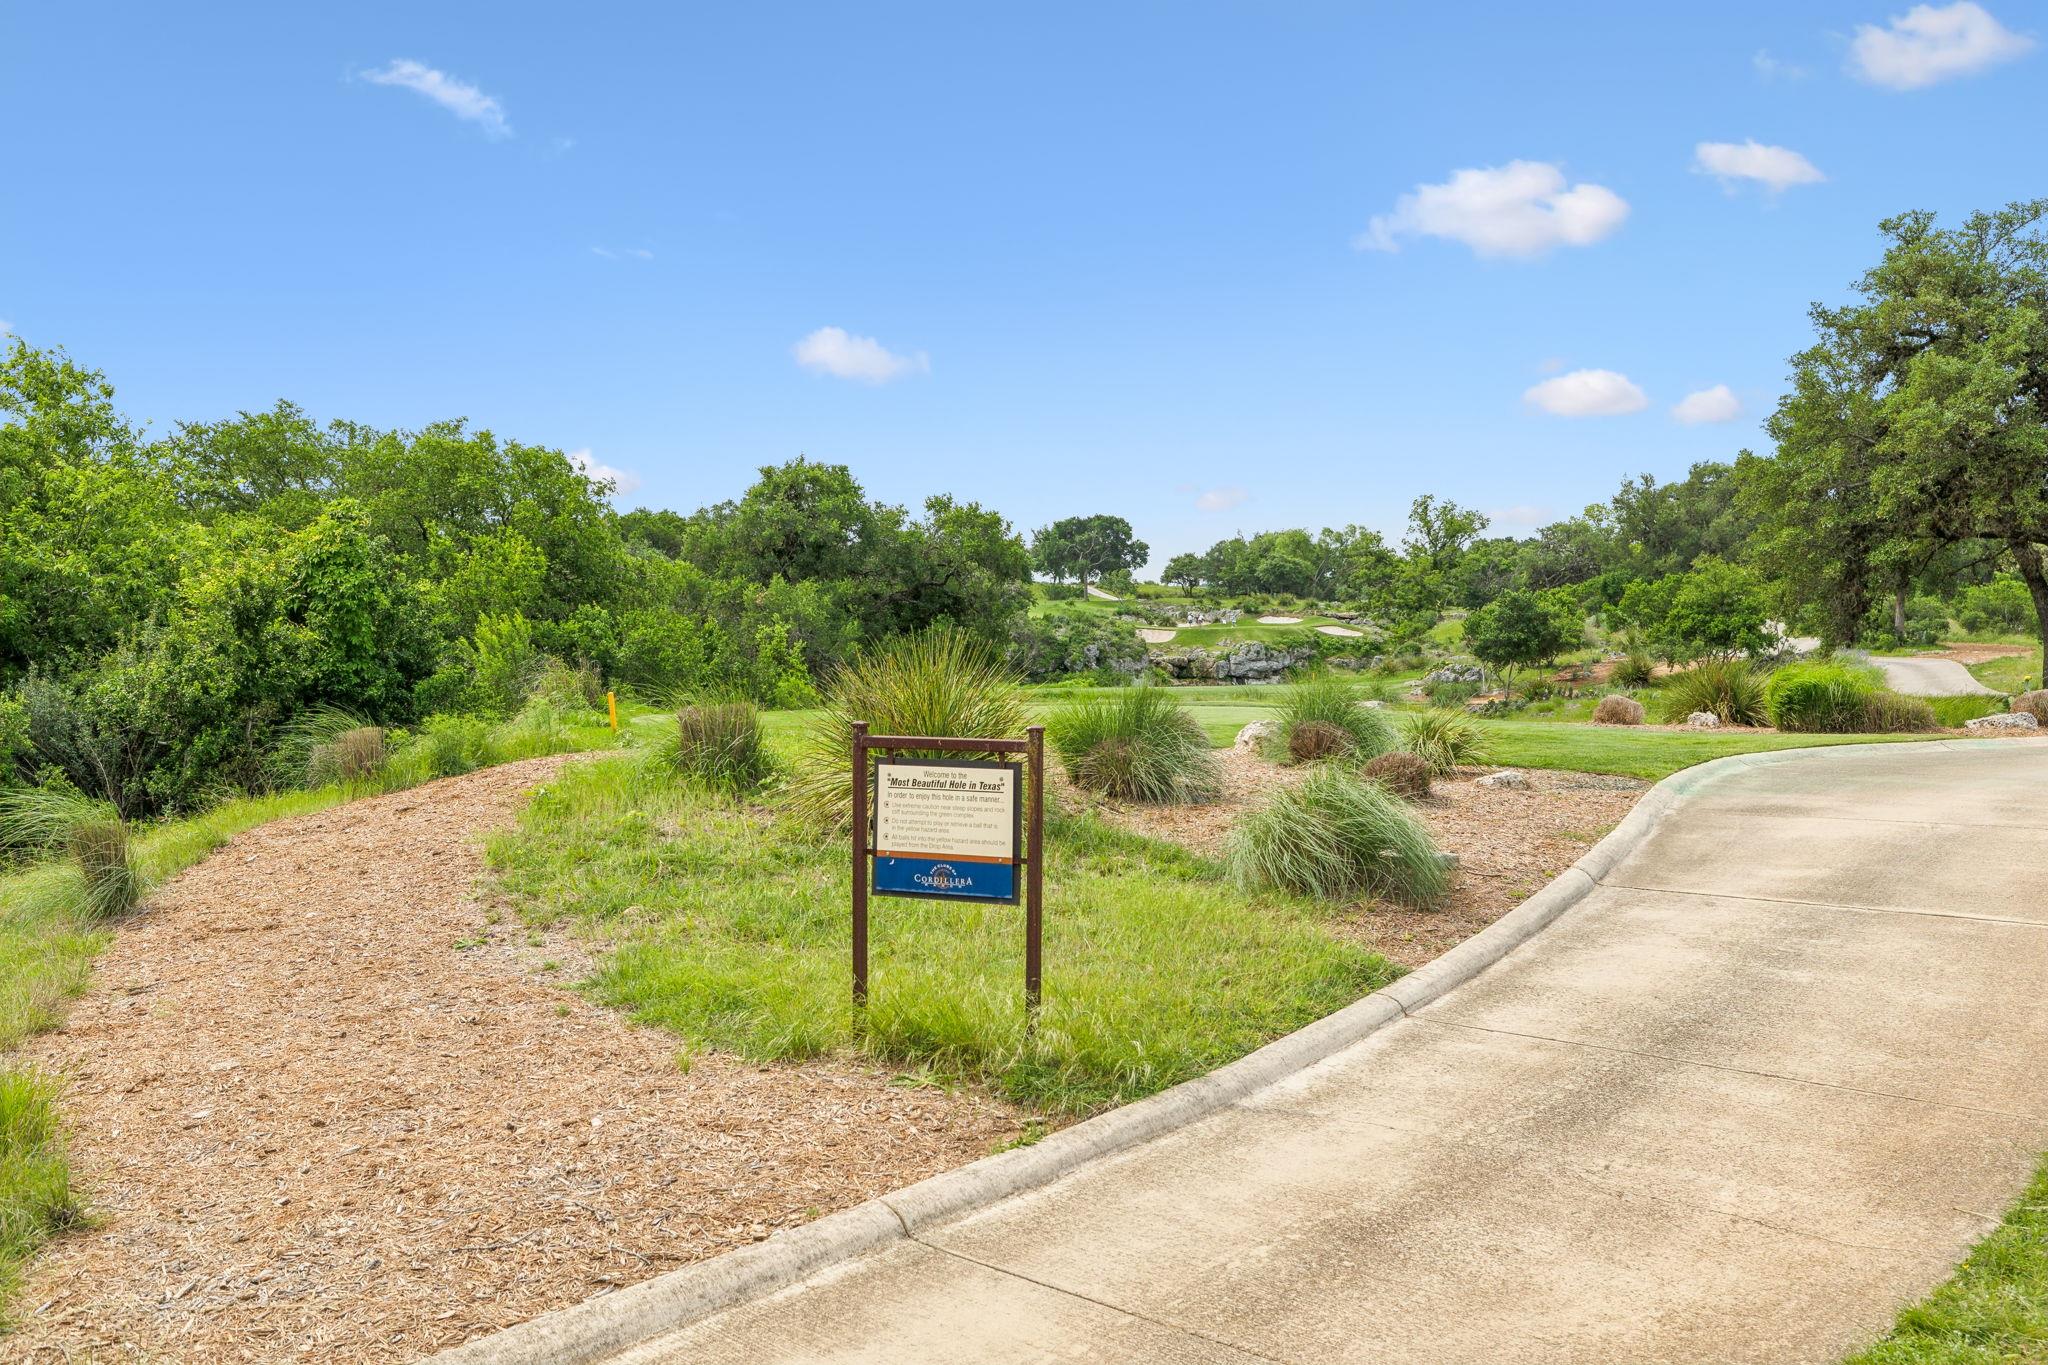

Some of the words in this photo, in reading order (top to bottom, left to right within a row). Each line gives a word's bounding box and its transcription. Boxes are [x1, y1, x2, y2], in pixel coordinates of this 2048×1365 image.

[924, 770, 950, 778] Welcome
[912, 778, 948, 788] Beautiful
[949, 780, 966, 789] Hole
[969, 780, 976, 789] in
[980, 782, 1005, 790] Texas"
[916, 793, 930, 801] enjoy
[914, 874, 972, 886] CORDILLERA
